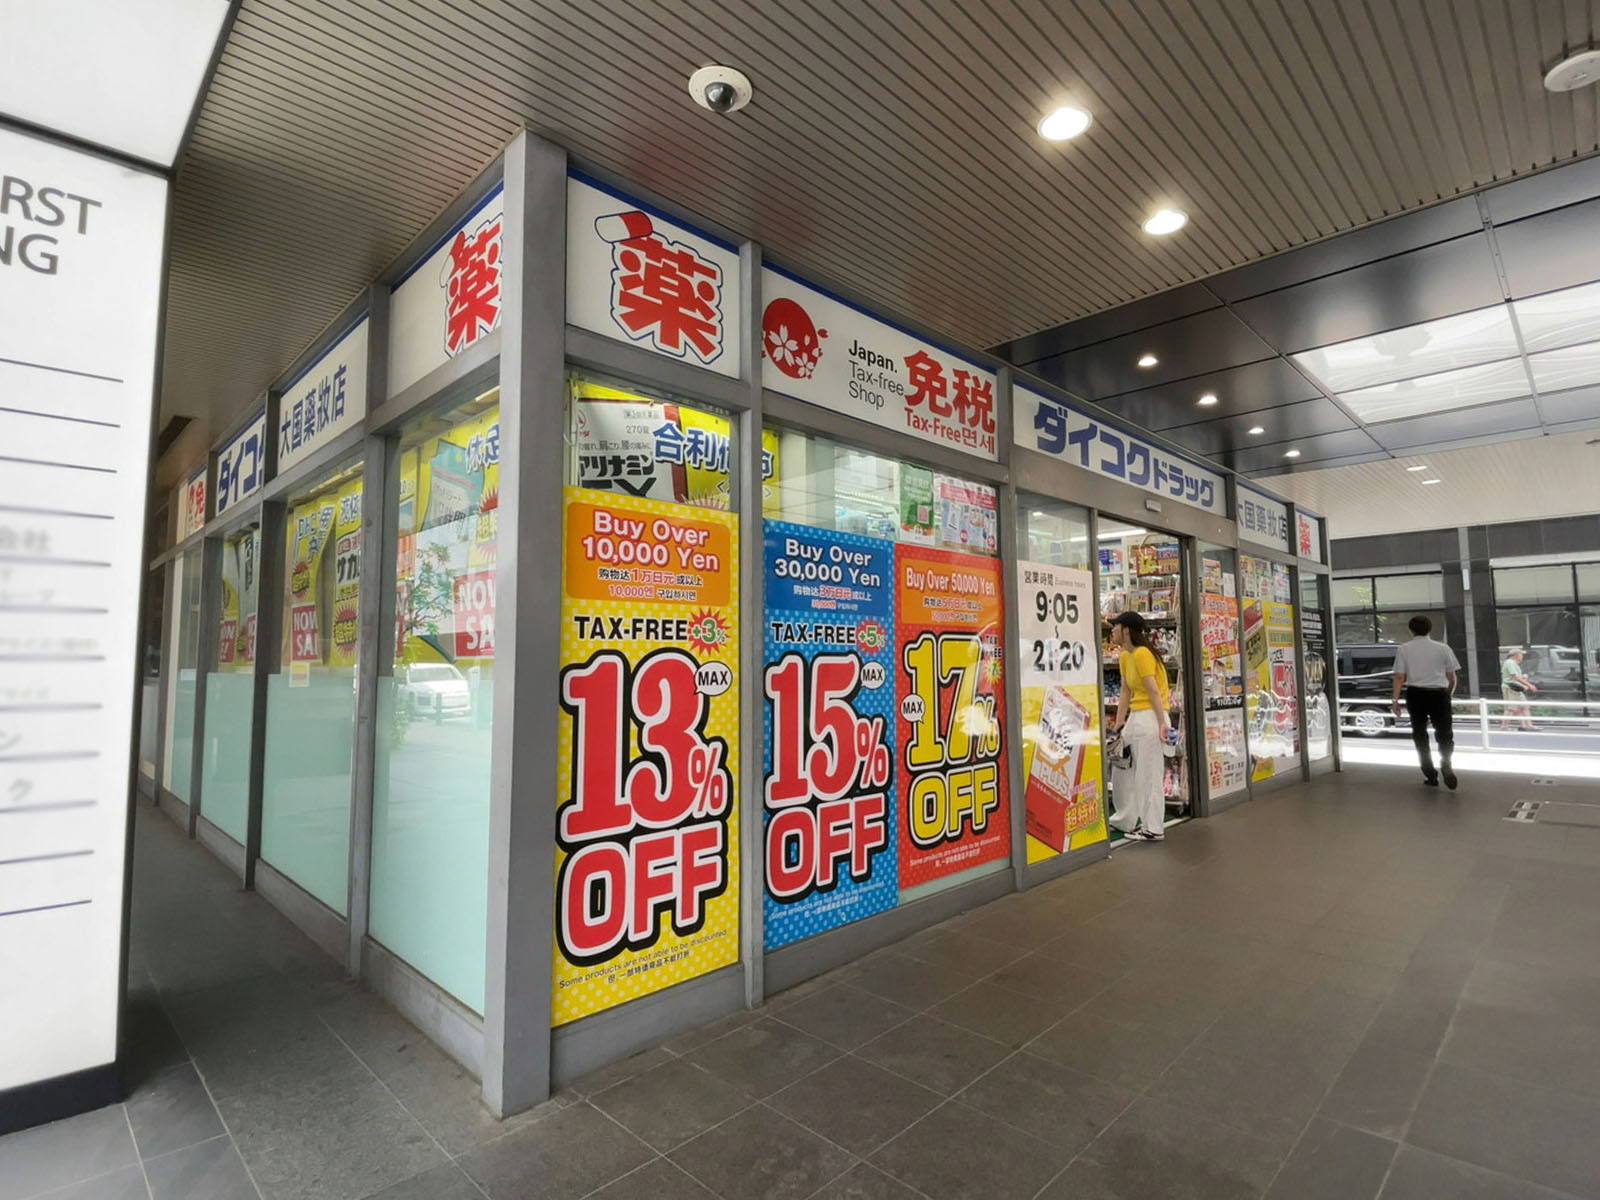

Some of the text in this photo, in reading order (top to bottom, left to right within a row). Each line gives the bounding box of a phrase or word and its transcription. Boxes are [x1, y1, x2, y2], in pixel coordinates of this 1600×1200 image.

[0, 175, 102, 235] RST
[618, 236, 717, 357] 薬
[848, 340, 898, 373] Japan.
[848, 360, 904, 396] Tax-free
[848, 380, 884, 410] Shop
[904, 350, 995, 434] 免税
[1033, 401, 1214, 508] ダイコクドラッグ
[593, 510, 709, 546] Buy Over
[583, 536, 720, 571] 10,000 Yen
[785, 538, 872, 567] Buy Over
[774, 558, 881, 587] 30,000 Yen
[906, 567, 995, 596] Buy Over 50,000 Yen
[1025, 571, 1054, 586] 営業時間
[1036, 590, 1079, 624] 9:05
[574, 616, 688, 641] TAX-FREE
[771, 622, 857, 644] TAX-FREE
[698, 669, 729, 687] MAX
[862, 668, 884, 682] MAX
[902, 701, 923, 714] MAX
[911, 764, 997, 842] OFF
[768, 794, 885, 895] OFF
[564, 823, 722, 954] OFF
[559, 929, 727, 989] Some products are not able to be discounted
